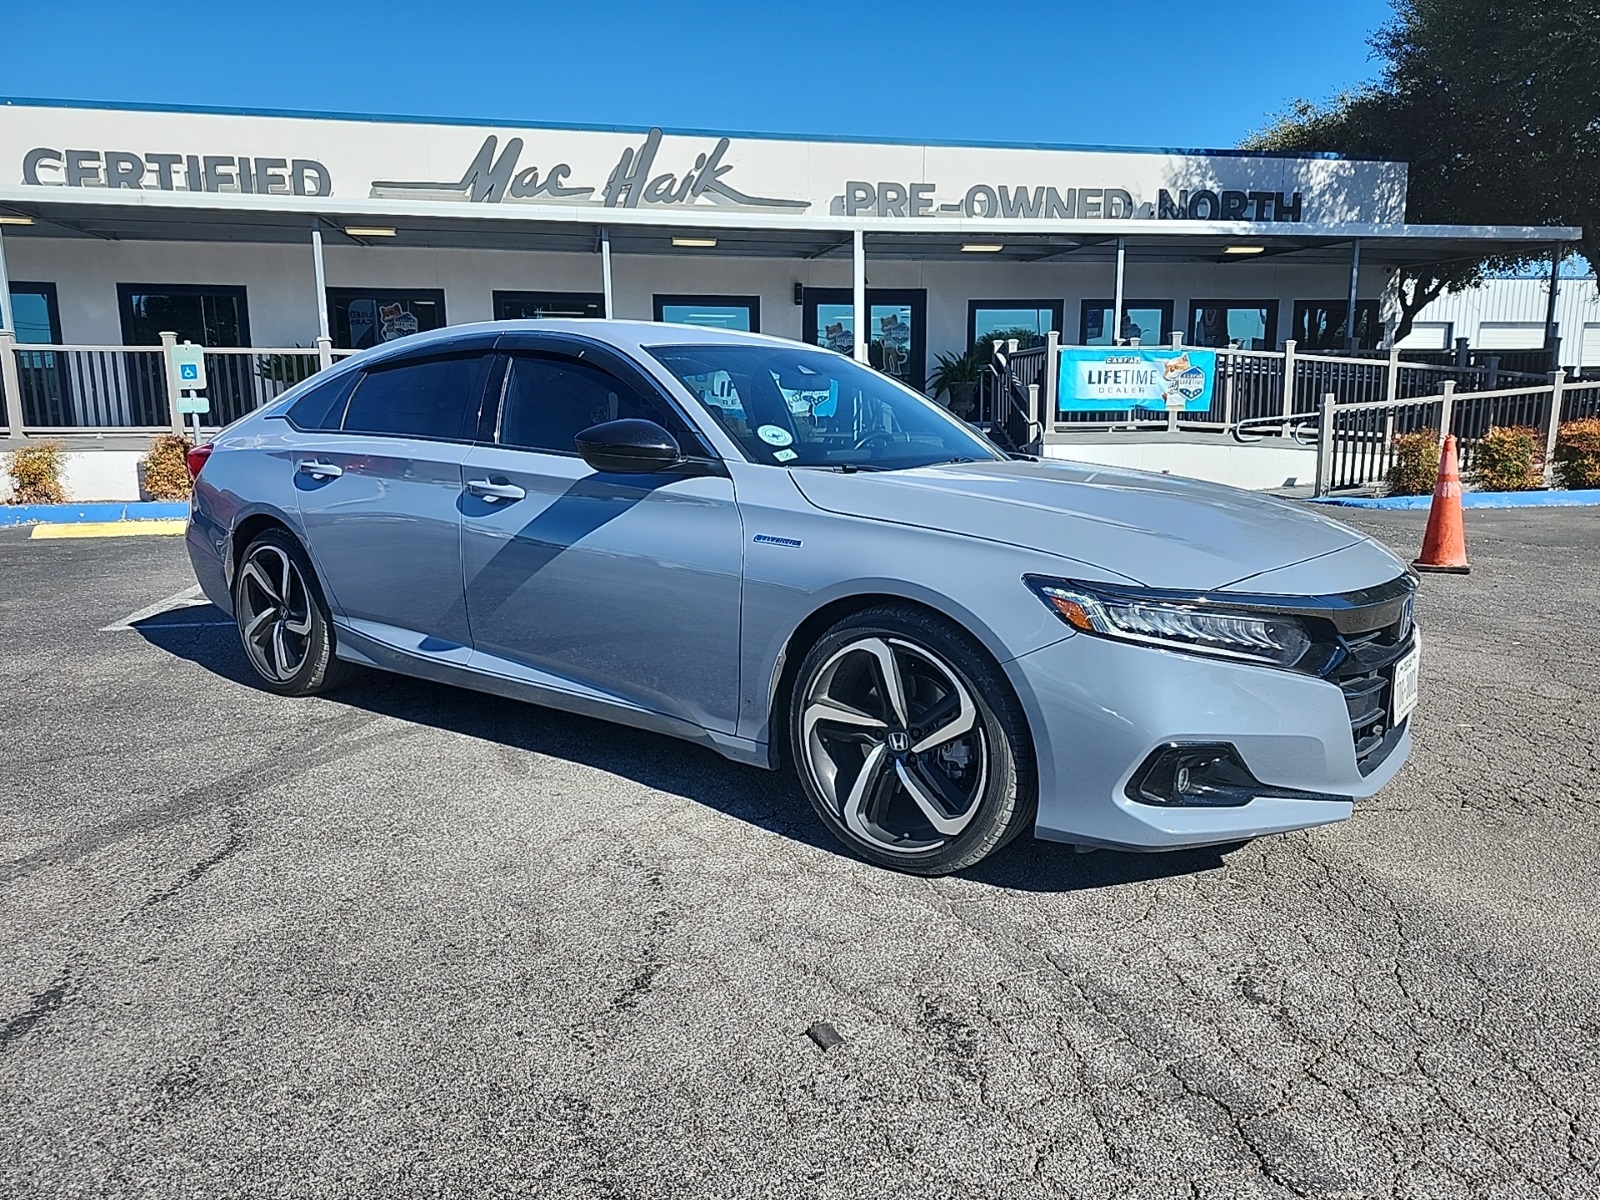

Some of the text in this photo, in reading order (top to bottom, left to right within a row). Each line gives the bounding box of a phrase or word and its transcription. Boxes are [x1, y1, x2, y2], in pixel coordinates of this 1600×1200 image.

[23, 148, 333, 198] CERTIFIED
[371, 127, 812, 208] Mac Haik
[1157, 188, 1301, 222] NORTH
[1087, 369, 1158, 385] LIFETIME
